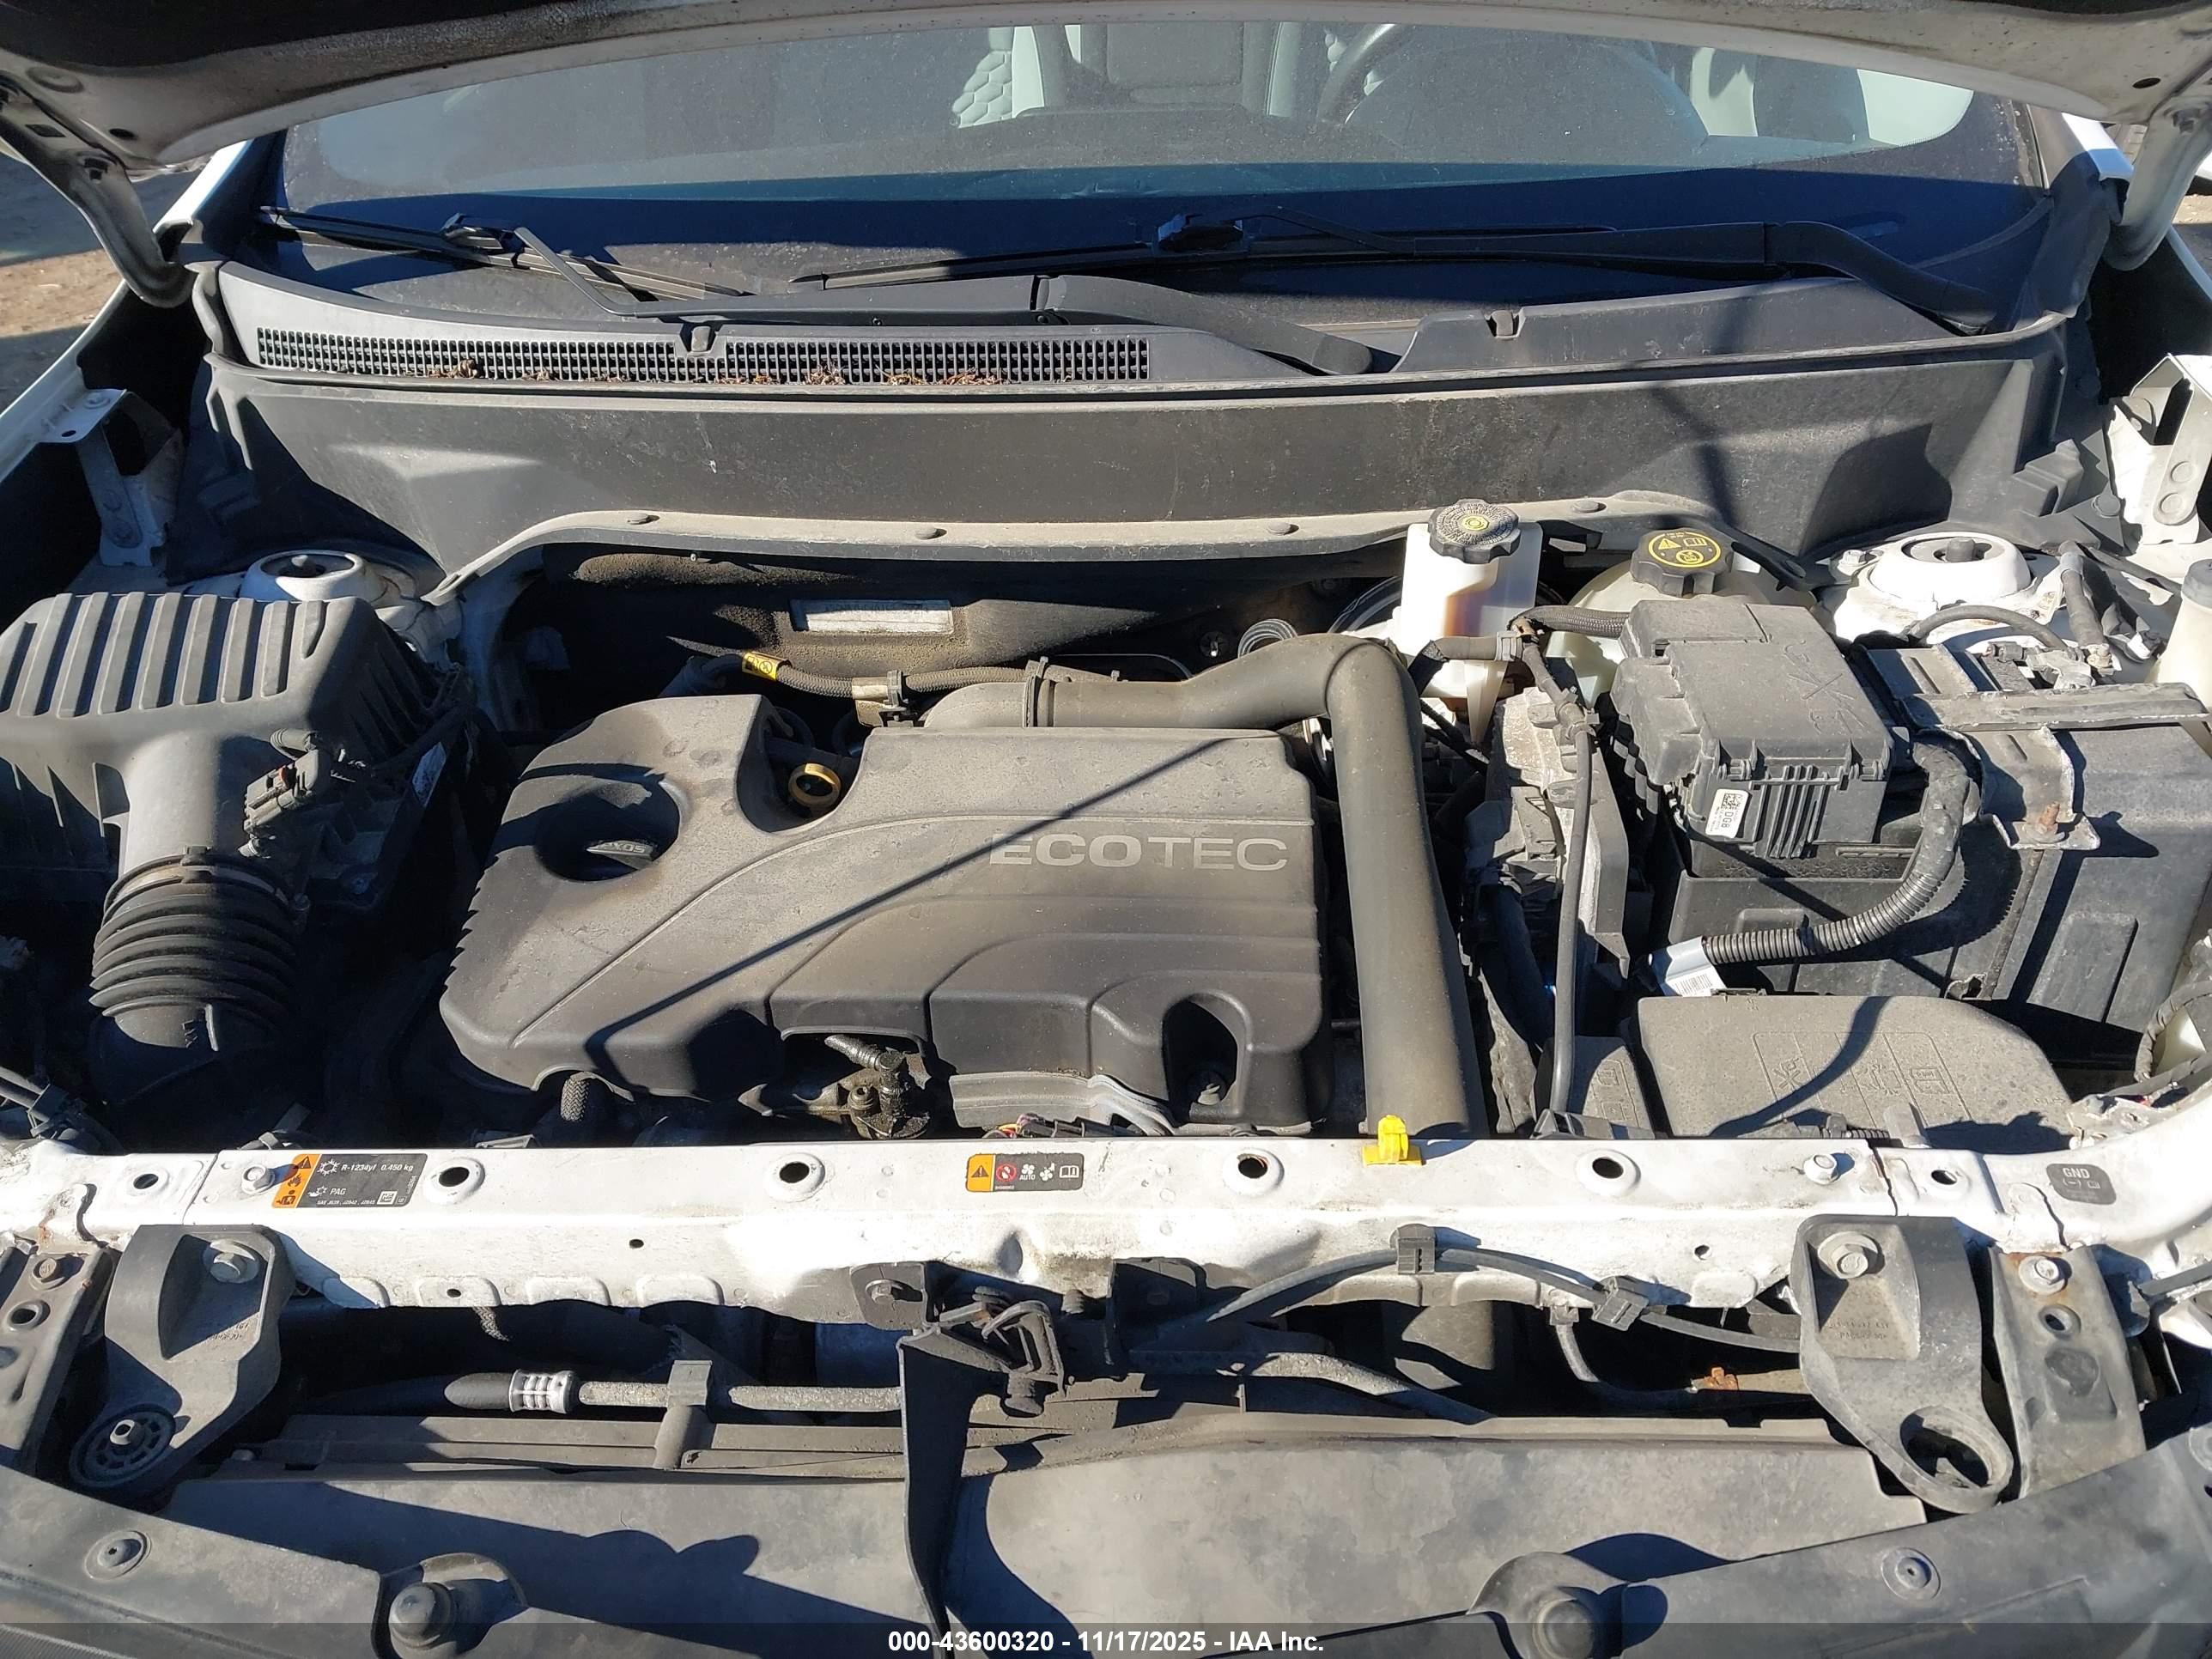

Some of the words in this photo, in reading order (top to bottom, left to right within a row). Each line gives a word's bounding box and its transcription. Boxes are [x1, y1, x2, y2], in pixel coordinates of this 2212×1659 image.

[989, 834, 1288, 871] ECOTEC
[341, 1164, 377, 1173] R-1234yf
[404, 1164, 414, 1172] kg
[2063, 1168, 2090, 1179] GND
